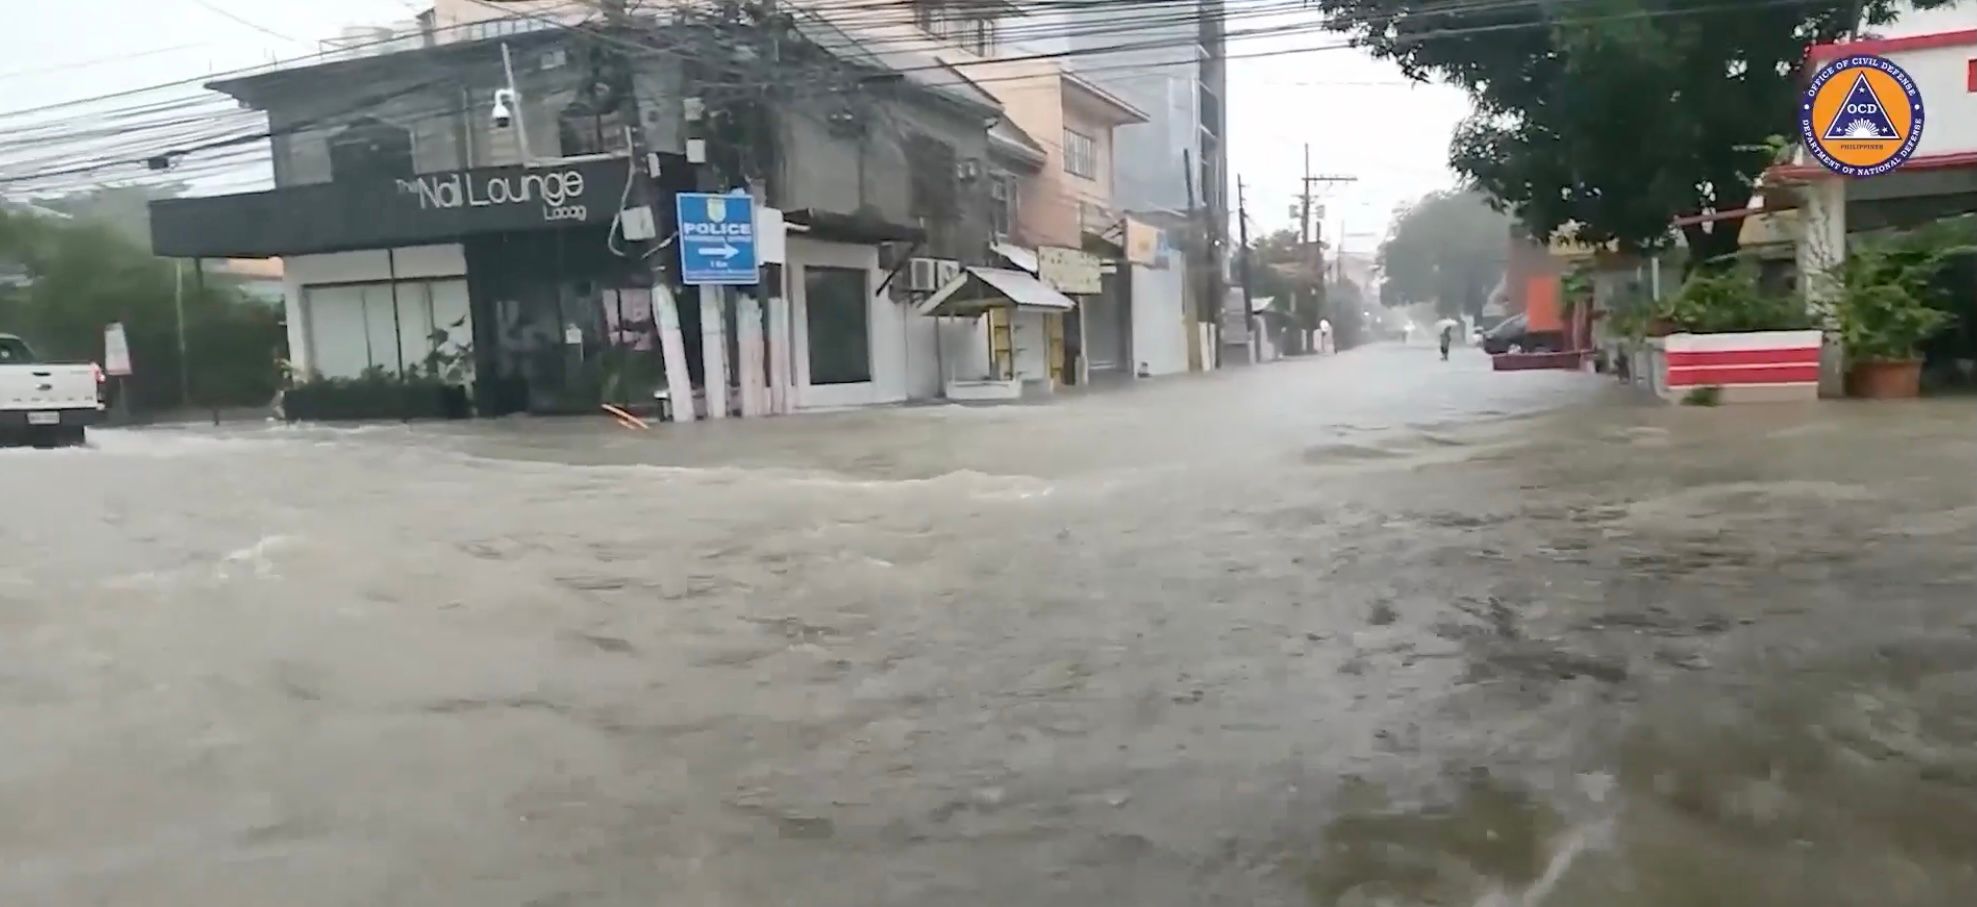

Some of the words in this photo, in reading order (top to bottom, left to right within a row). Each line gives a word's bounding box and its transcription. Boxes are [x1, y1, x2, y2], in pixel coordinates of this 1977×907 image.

[416, 173, 463, 209] Nail
[465, 170, 584, 207] Lounge
[683, 222, 752, 235] POLICE
